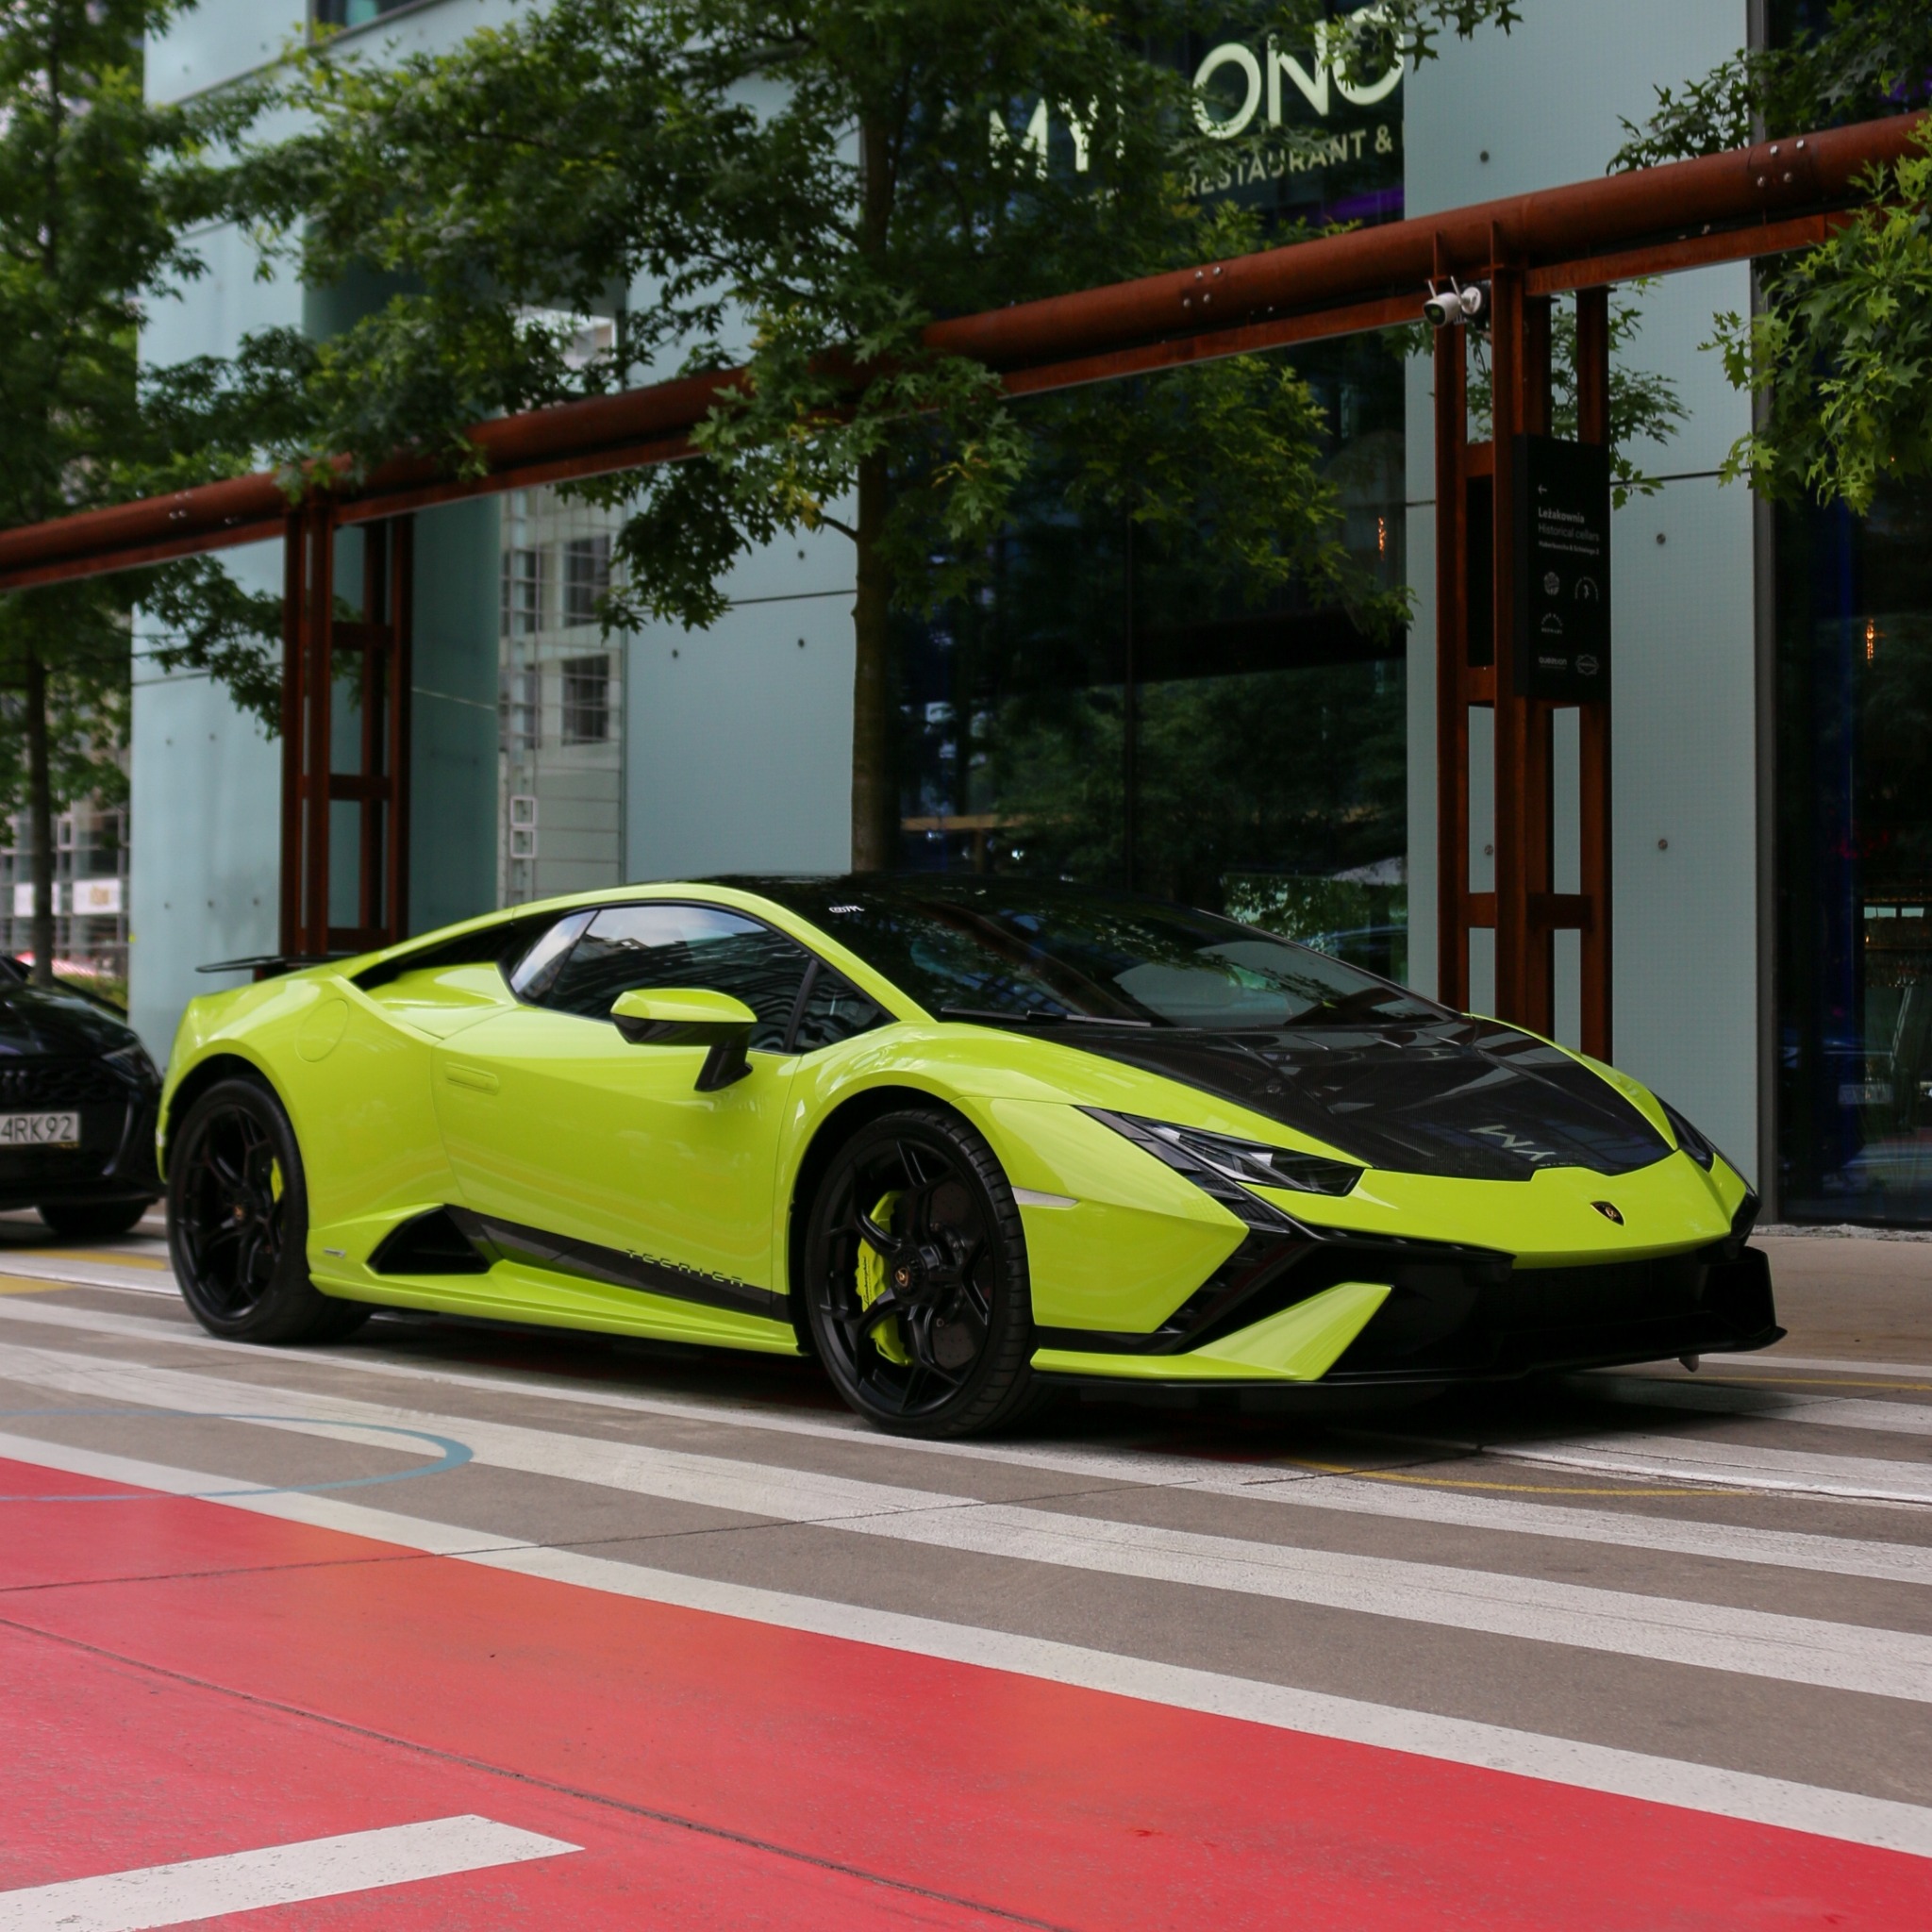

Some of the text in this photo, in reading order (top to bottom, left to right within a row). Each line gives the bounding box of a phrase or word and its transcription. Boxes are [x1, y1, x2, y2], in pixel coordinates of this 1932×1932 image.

[1374, 125, 1393, 155] &
[1538, 506, 1585, 525] Leżakownia
[1538, 523, 1574, 537] Historical
[1, 1116, 72, 1141] 4RK92
[626, 1249, 743, 1288] TECNICA
